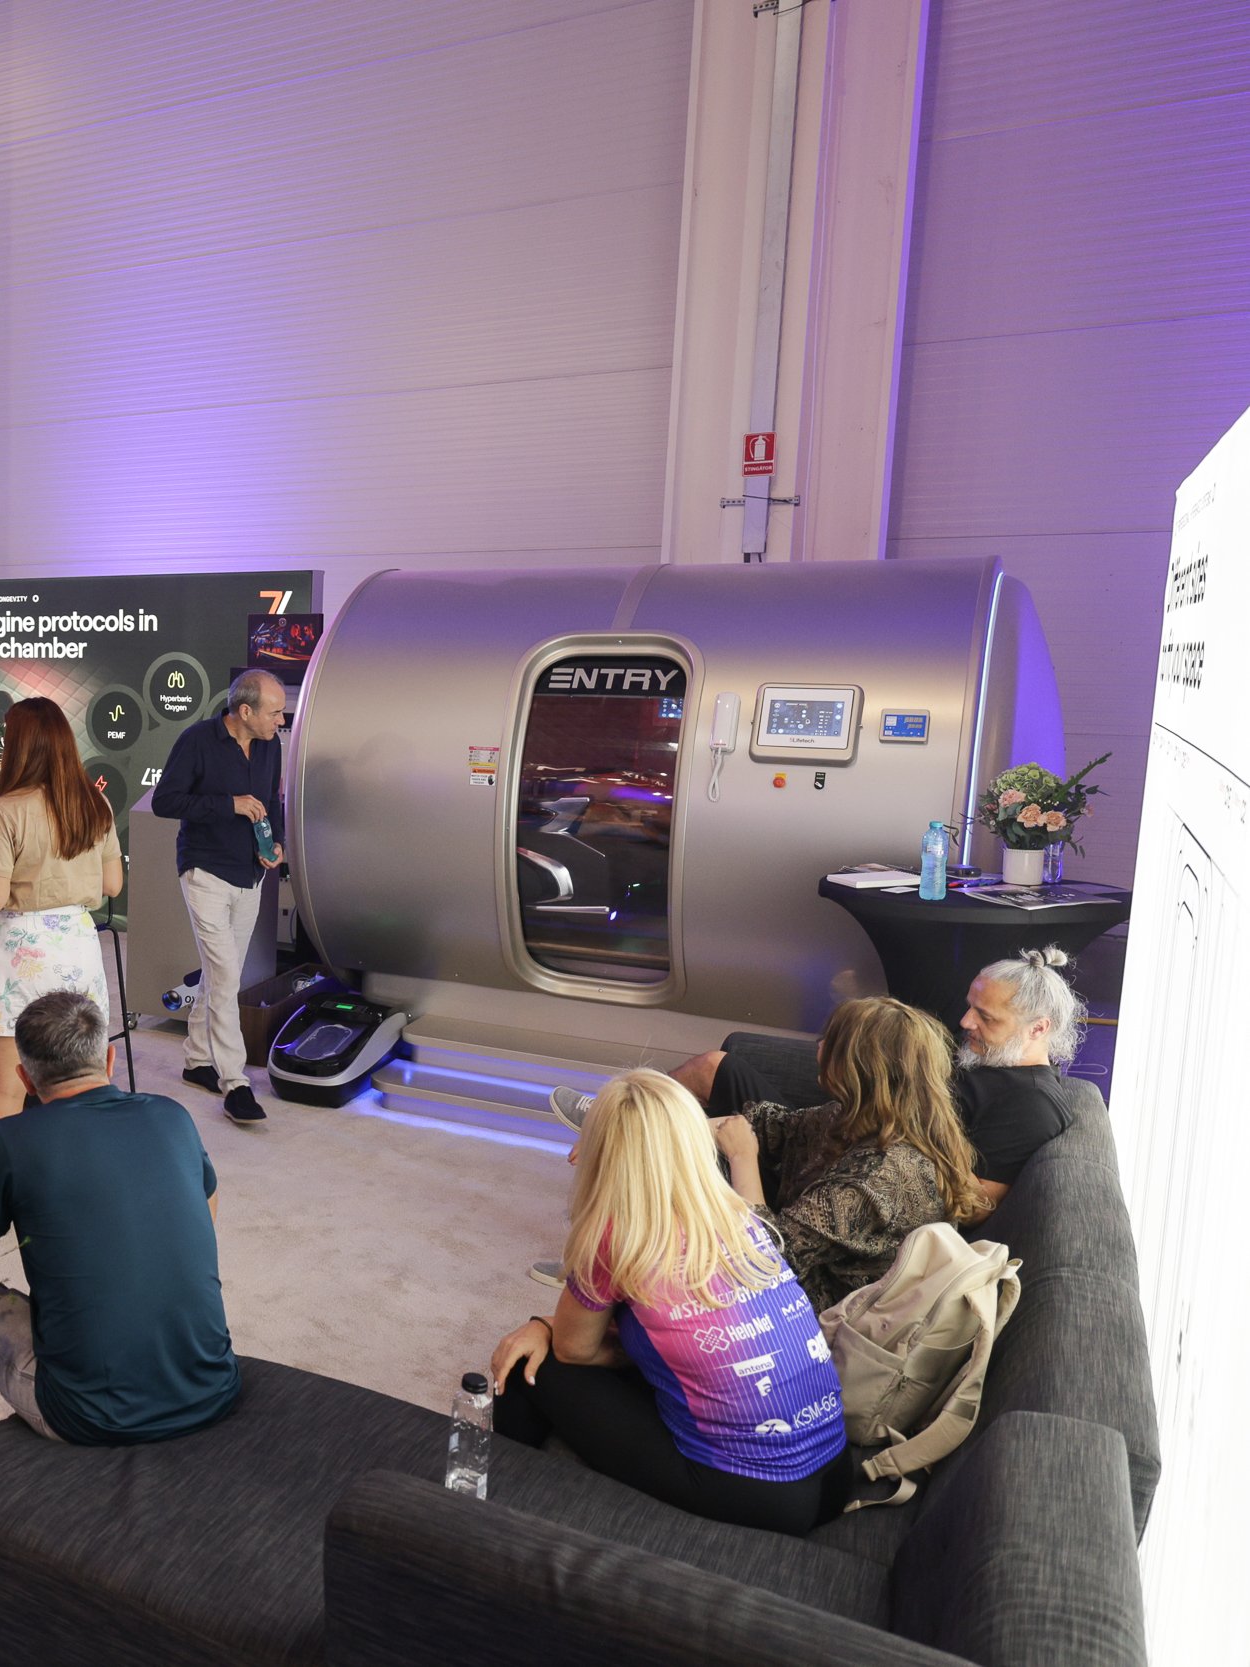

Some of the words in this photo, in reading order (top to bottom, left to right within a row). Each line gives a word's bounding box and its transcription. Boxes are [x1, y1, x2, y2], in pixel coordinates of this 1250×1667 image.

[38, 608, 135, 637] protocols
[138, 608, 158, 632] in
[548, 667, 679, 691] ENTRY
[159, 694, 192, 704] Hyperbaric
[164, 703, 187, 712] Oxygen
[107, 731, 126, 740] PEMF
[738, 1360, 773, 1376] antena
[793, 1391, 837, 1429] KSM-66
